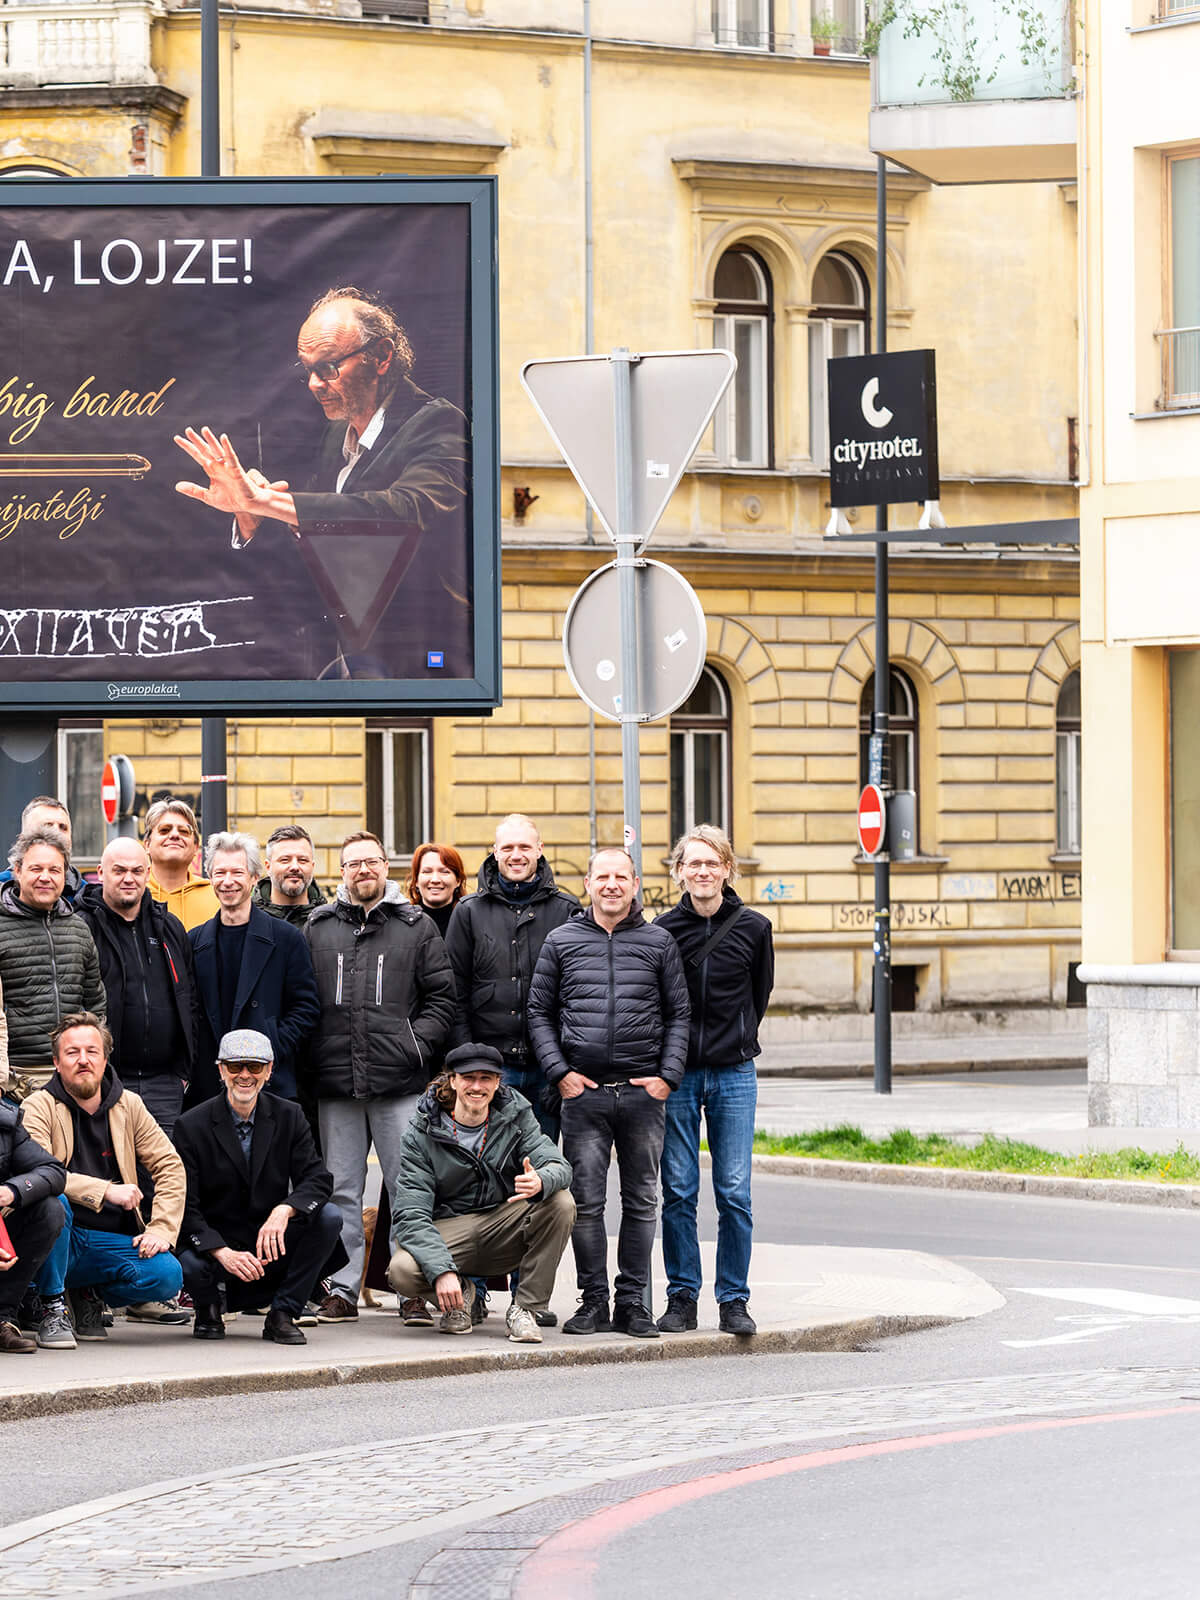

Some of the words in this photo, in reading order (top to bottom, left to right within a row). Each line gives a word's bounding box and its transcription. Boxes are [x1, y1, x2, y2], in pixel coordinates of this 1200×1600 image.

[73, 238, 253, 286] LOJZE!
[63, 376, 177, 418] band
[120, 683, 178, 697] europlakat
